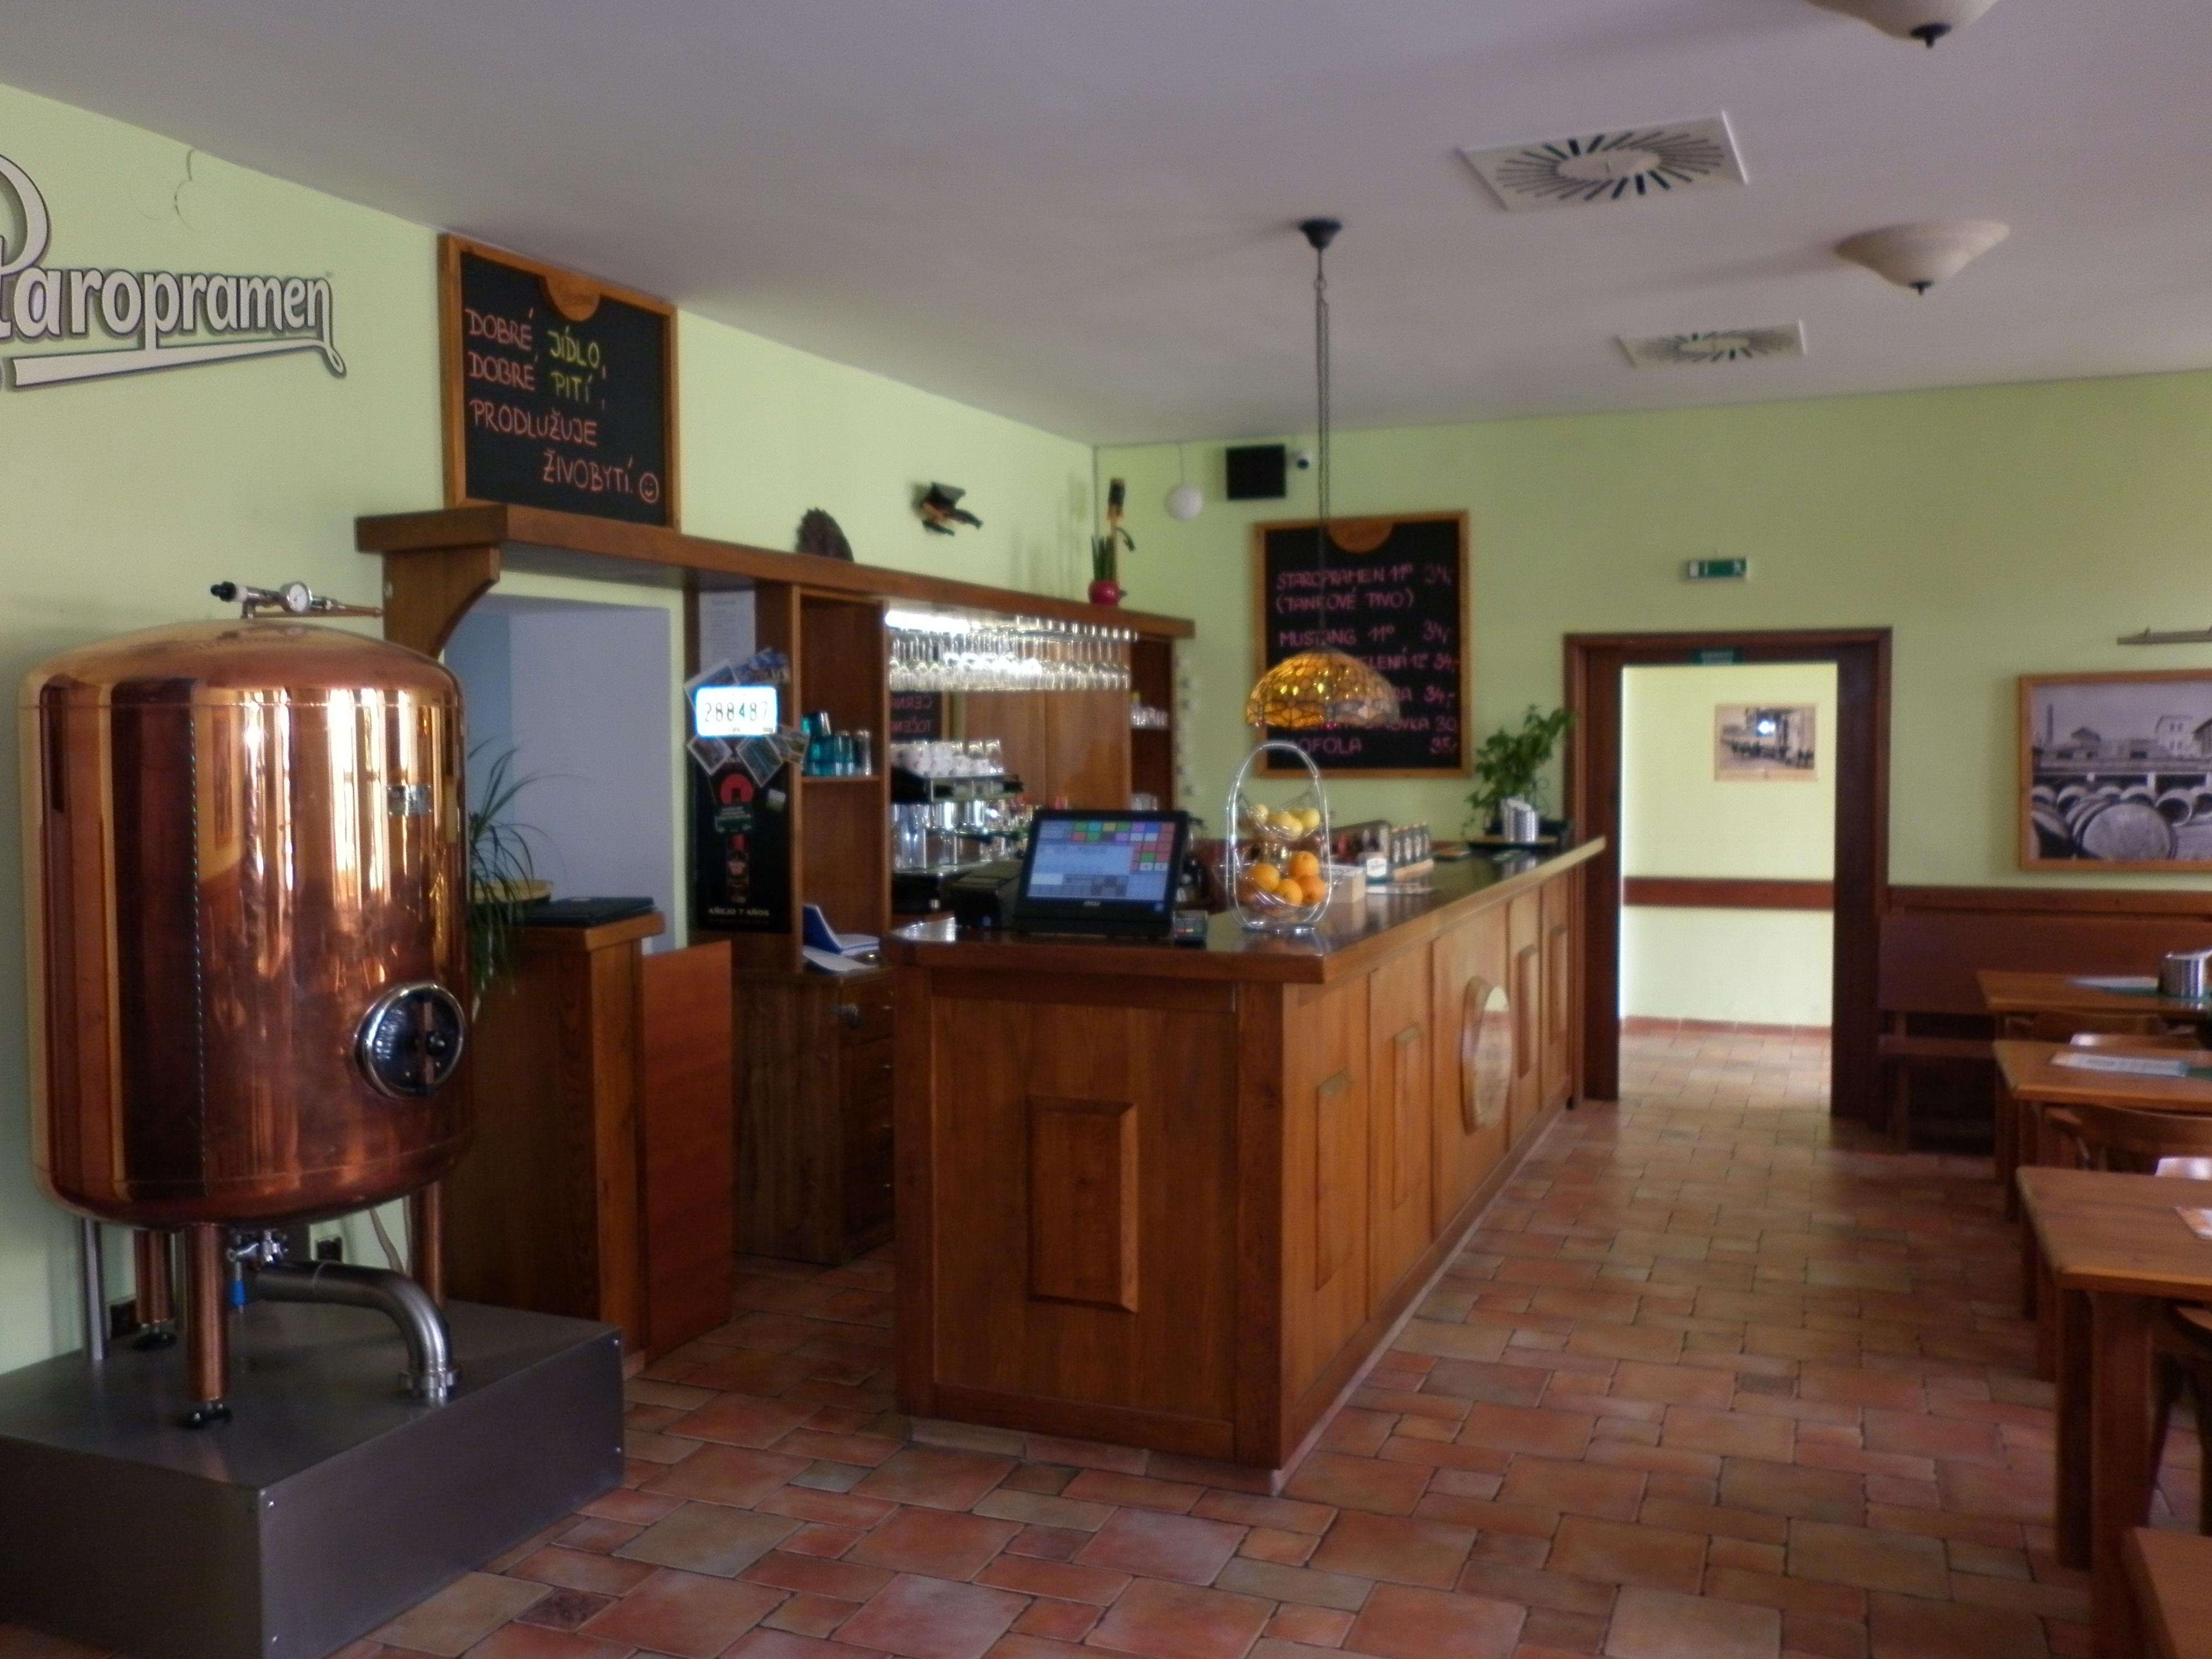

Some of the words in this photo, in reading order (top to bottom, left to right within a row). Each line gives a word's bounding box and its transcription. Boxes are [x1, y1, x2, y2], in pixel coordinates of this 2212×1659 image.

[0, 155, 347, 387] aropramen
[465, 307, 534, 351] DOBRÉ
[468, 351, 538, 391] DOBRÉ
[470, 399, 597, 446] PRODLUŽUJE
[1300, 736, 1361, 755] OFOLA
